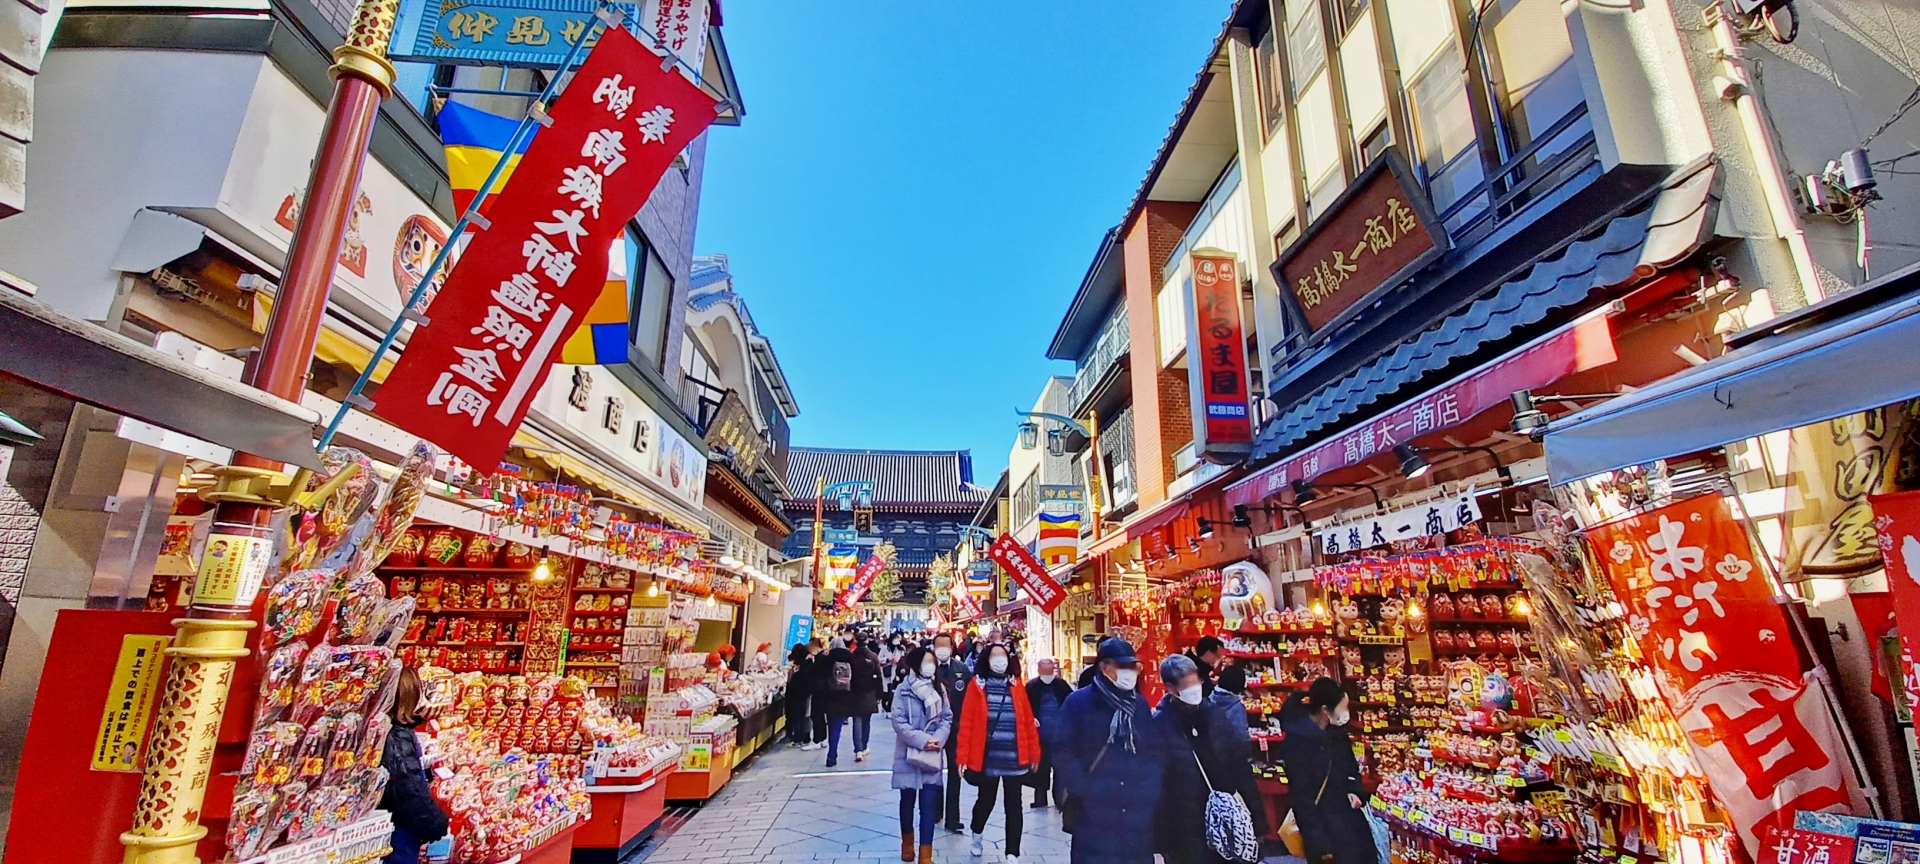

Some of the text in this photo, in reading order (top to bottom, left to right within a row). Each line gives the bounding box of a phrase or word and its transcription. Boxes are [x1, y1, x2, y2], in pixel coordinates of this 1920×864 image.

[671, 0, 691, 50] おみやげ
[1205, 289, 1239, 395] だるま屋
[1804, 834, 1842, 846] プレミアム
